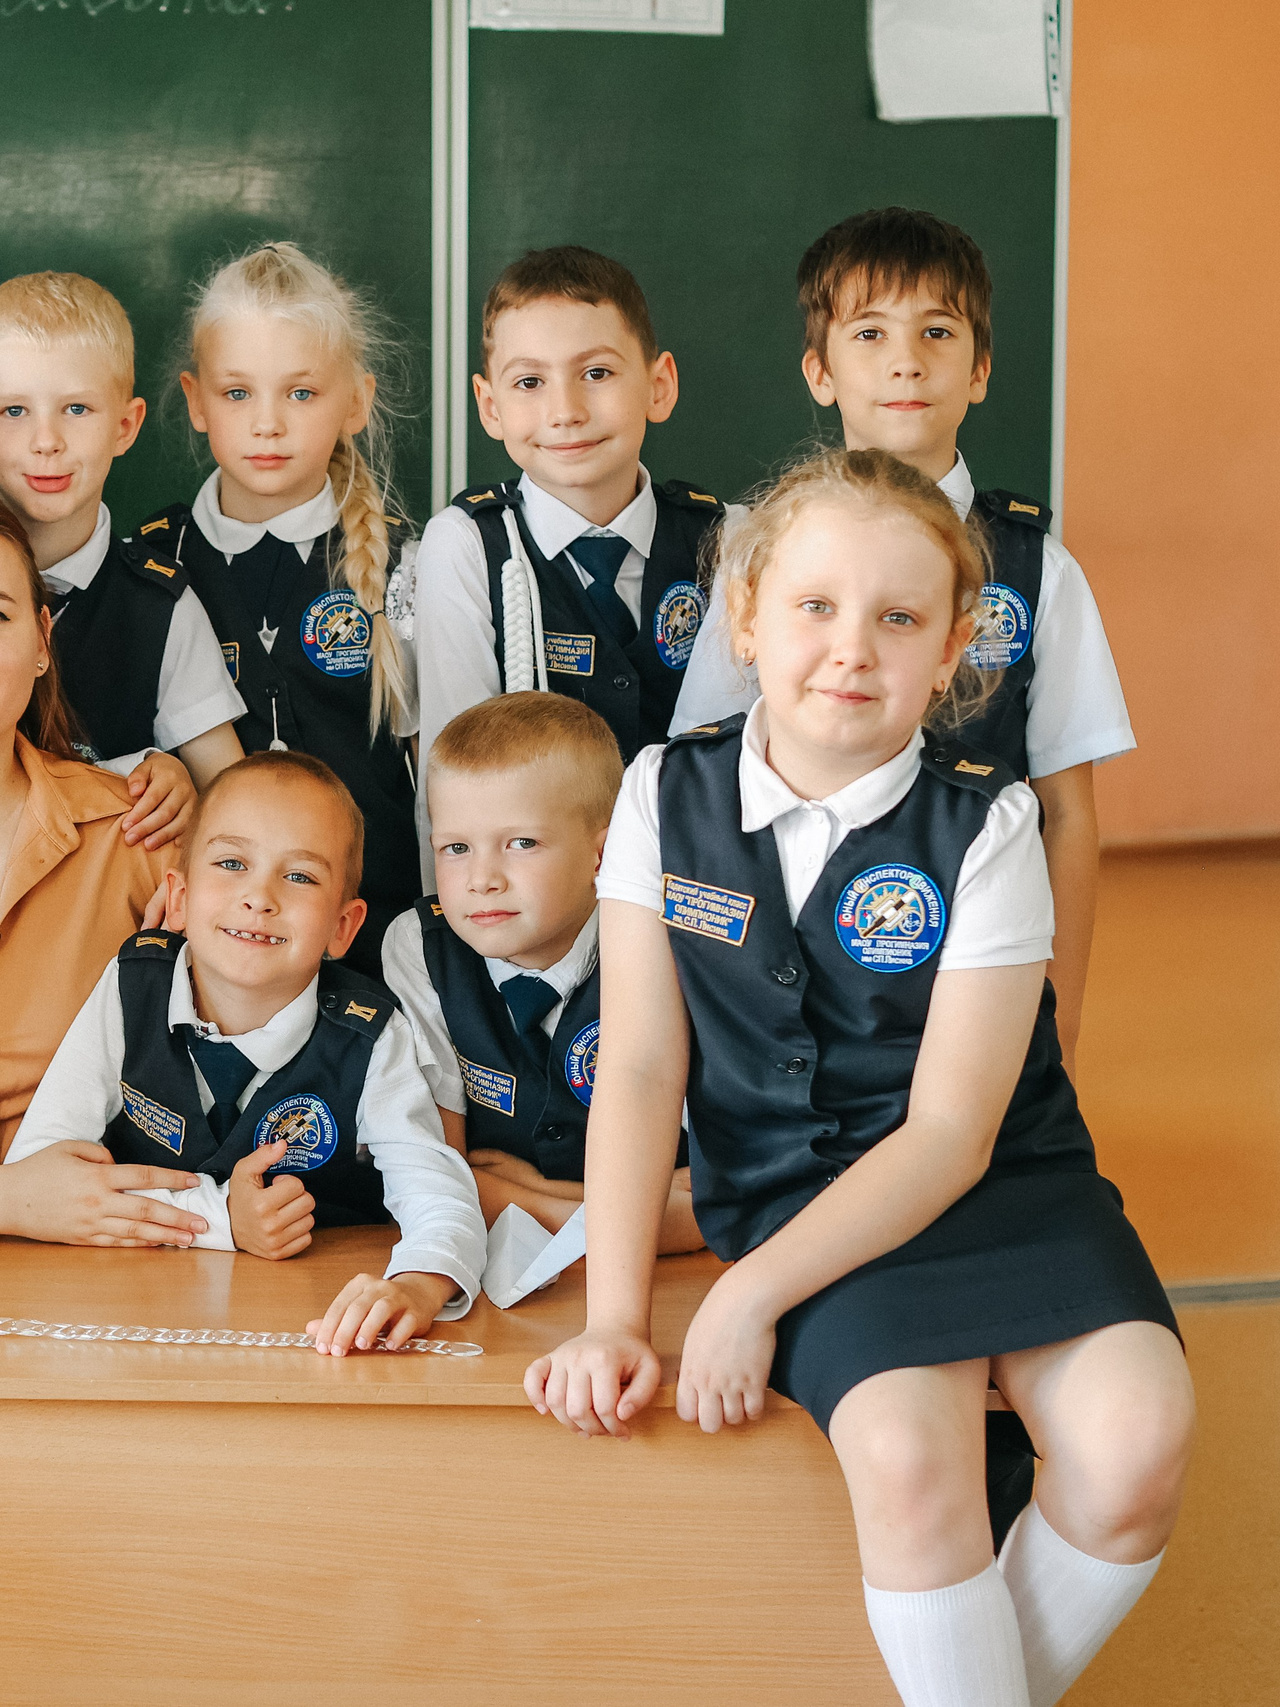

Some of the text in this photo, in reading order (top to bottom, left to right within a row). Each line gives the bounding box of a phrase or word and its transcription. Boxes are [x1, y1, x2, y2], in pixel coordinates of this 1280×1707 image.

[666, 890, 685, 903] МАОУ
[675, 904, 733, 926] ОЛИМПИОНИК"
[842, 869, 940, 928] ЮНЫЙ ИНСПЕКТОР ДВИЖЕНИЯ
[570, 1025, 600, 1085] ЮНЫЙ ИНСПЕ
[270, 1098, 314, 1120] ИНСПЕКТОР
[314, 1102, 333, 1144] ДВИЖЕНИЯ
